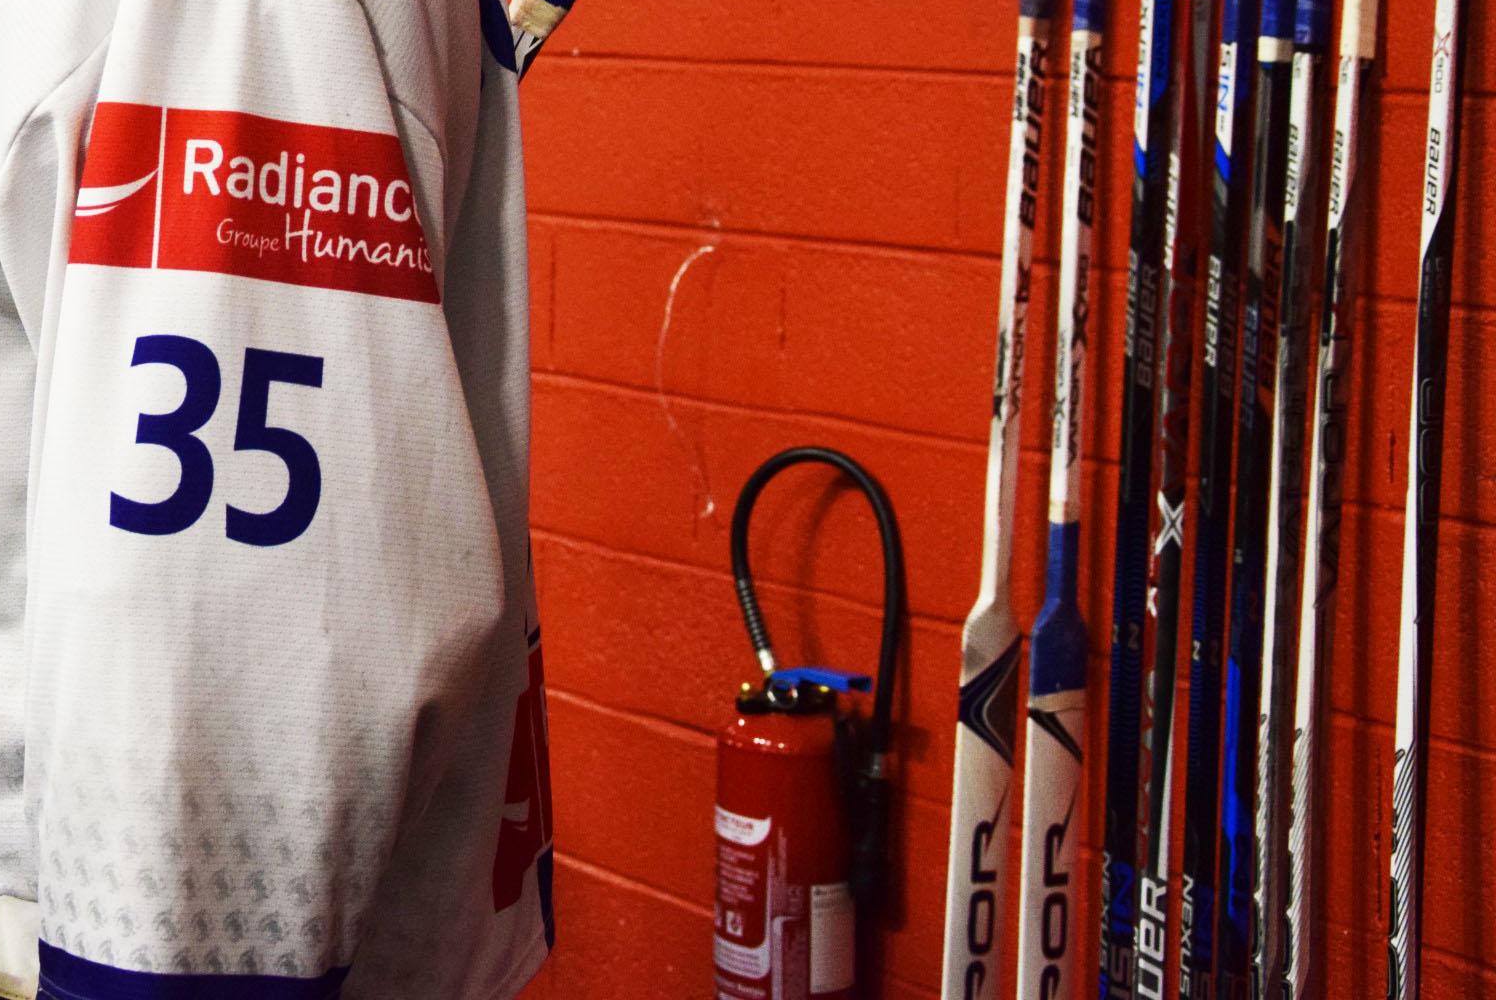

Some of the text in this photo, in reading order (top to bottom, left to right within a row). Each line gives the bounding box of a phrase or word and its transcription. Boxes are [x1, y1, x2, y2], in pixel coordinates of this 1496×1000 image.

[182, 138, 421, 224] Radianc
[1284, 123, 1299, 208] BAUER
[1329, 129, 1344, 216] BAUER
[1425, 127, 1442, 216] BAUER
[215, 216, 281, 260] Groupe
[1135, 262, 1159, 391] BAUER
[1206, 254, 1222, 369] BAUER
[109, 333, 325, 548] 35
[964, 788, 1010, 1000] POR
[1039, 788, 1080, 1000] POR
[1137, 876, 1168, 1000] UER
